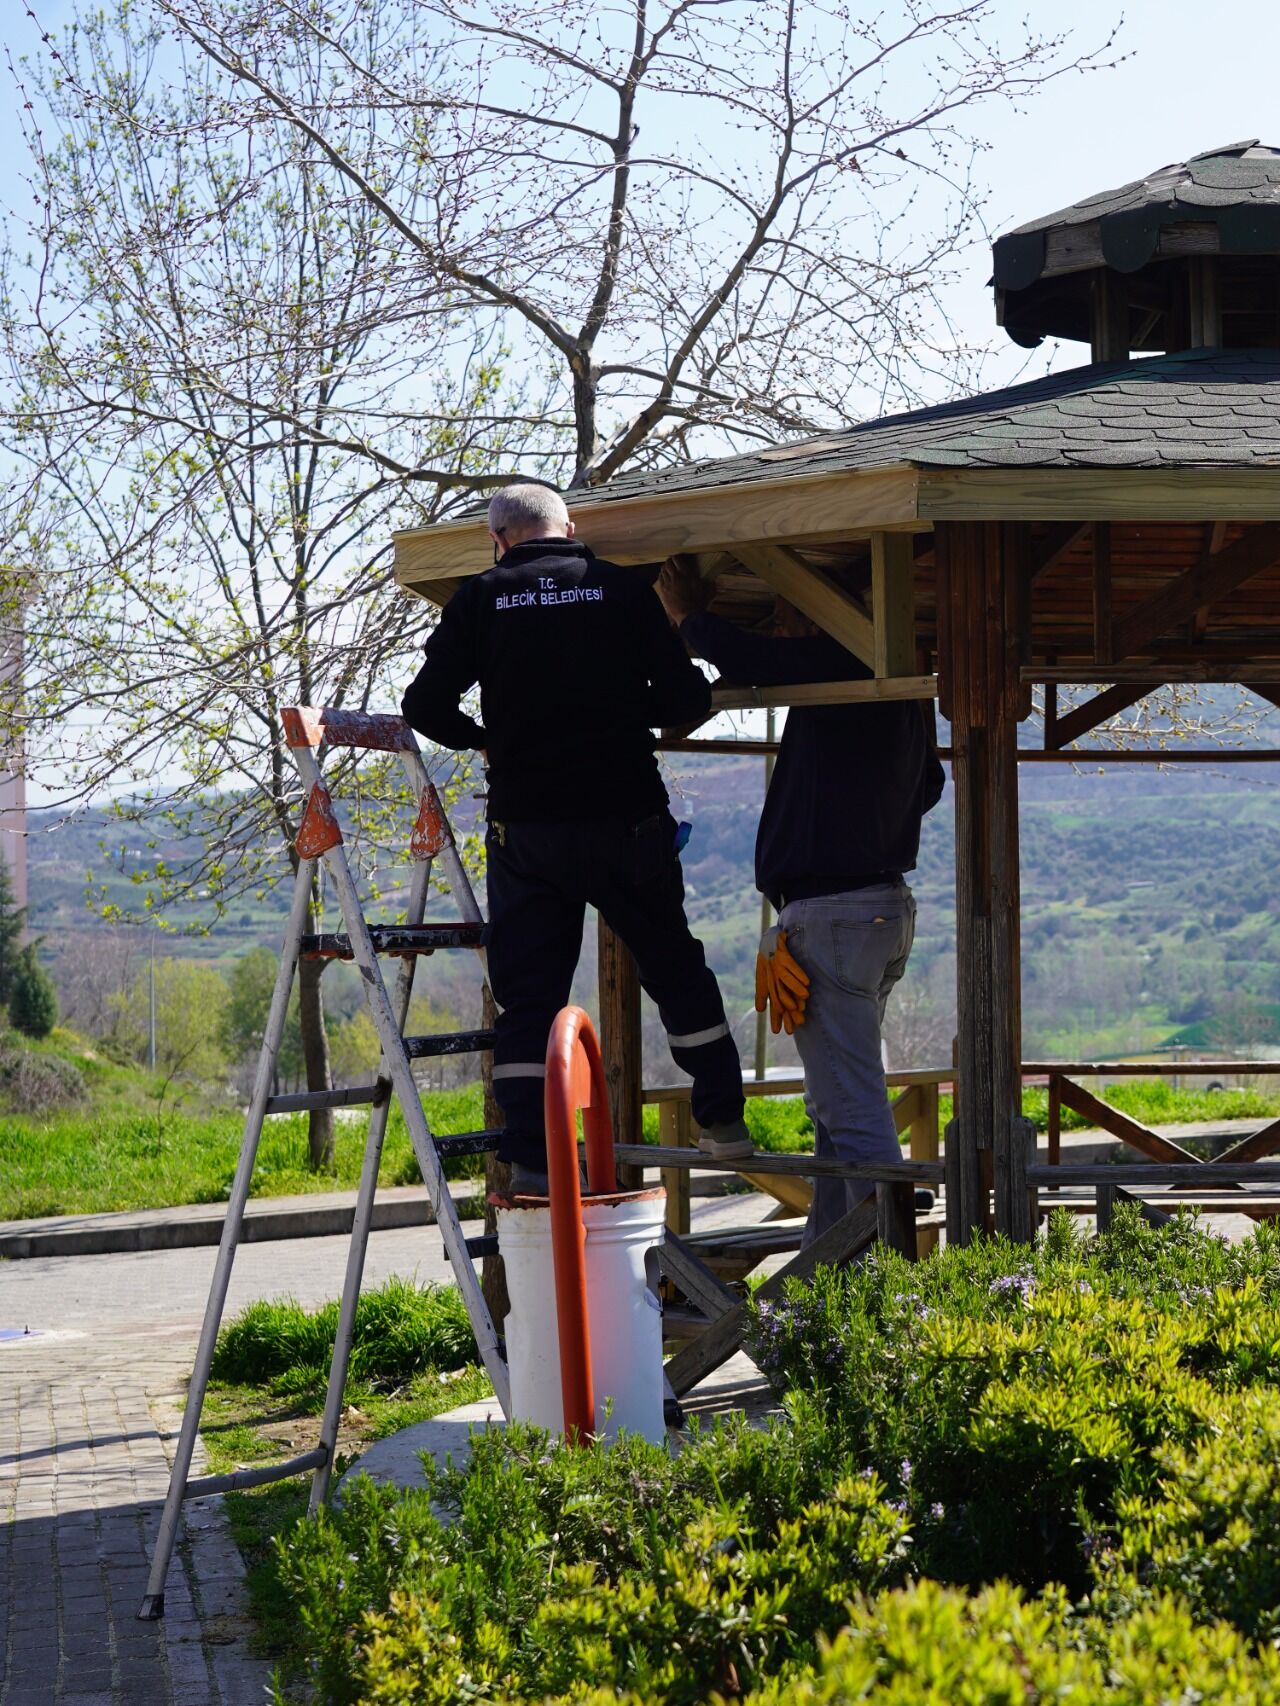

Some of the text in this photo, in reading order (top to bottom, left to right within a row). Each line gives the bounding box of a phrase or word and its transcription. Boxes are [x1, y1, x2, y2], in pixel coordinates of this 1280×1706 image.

[538, 577, 557, 589] T.C.
[496, 586, 603, 609] BİLECİK BELEDİYESİ
